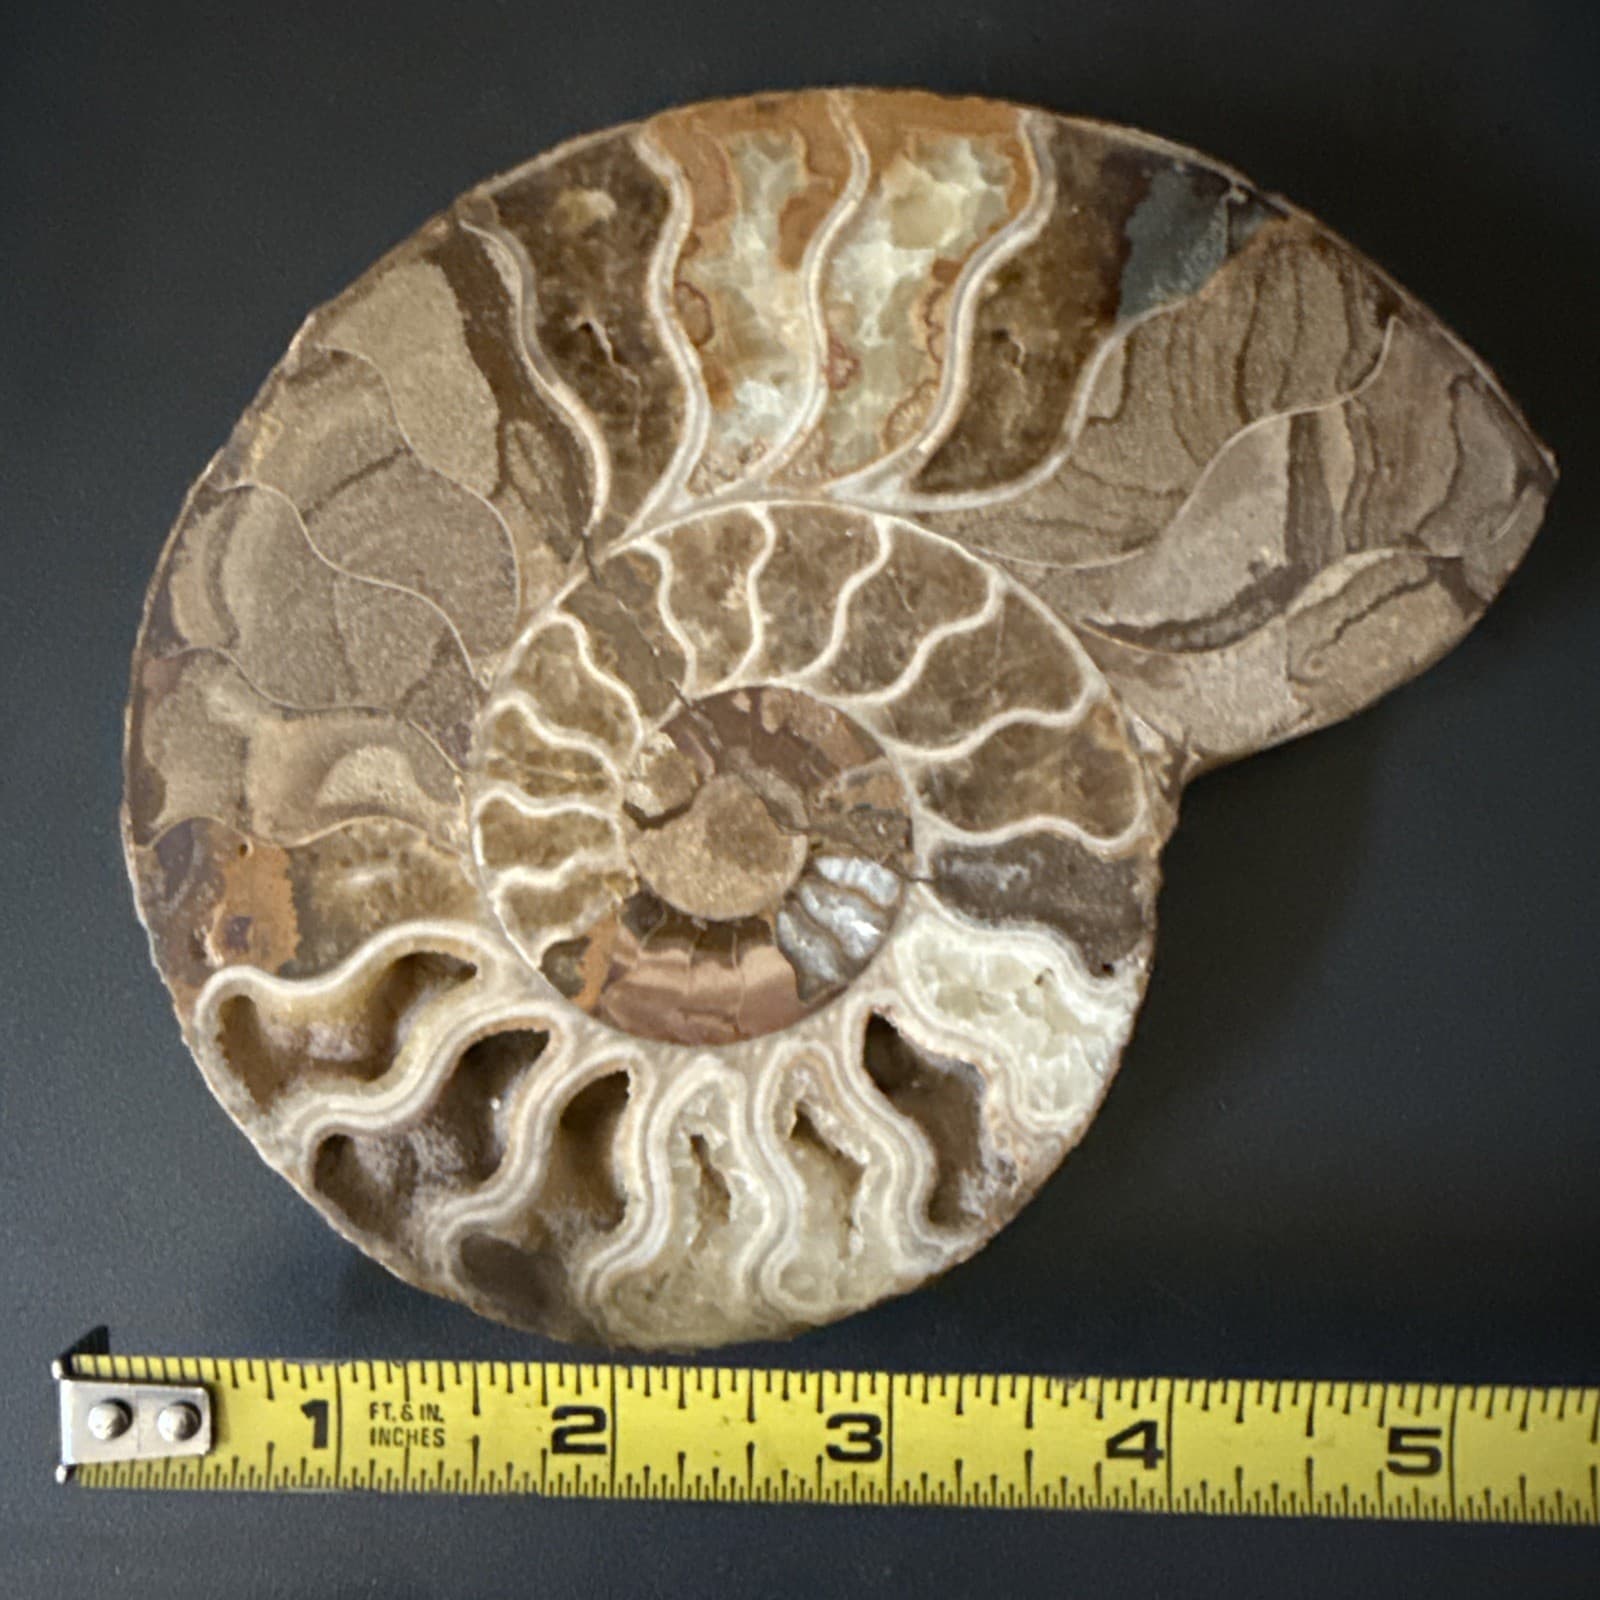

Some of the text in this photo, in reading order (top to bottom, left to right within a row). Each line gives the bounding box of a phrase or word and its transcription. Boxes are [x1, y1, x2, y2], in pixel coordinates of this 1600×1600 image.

[301, 1400, 328, 1449] 1
[369, 1401, 445, 1423] FT. & IN.
[551, 1406, 607, 1455] 2
[369, 1427, 445, 1448] INCHES
[825, 1413, 883, 1463] 3
[1105, 1420, 1165, 1470] 4
[1386, 1426, 1442, 1477] 5
